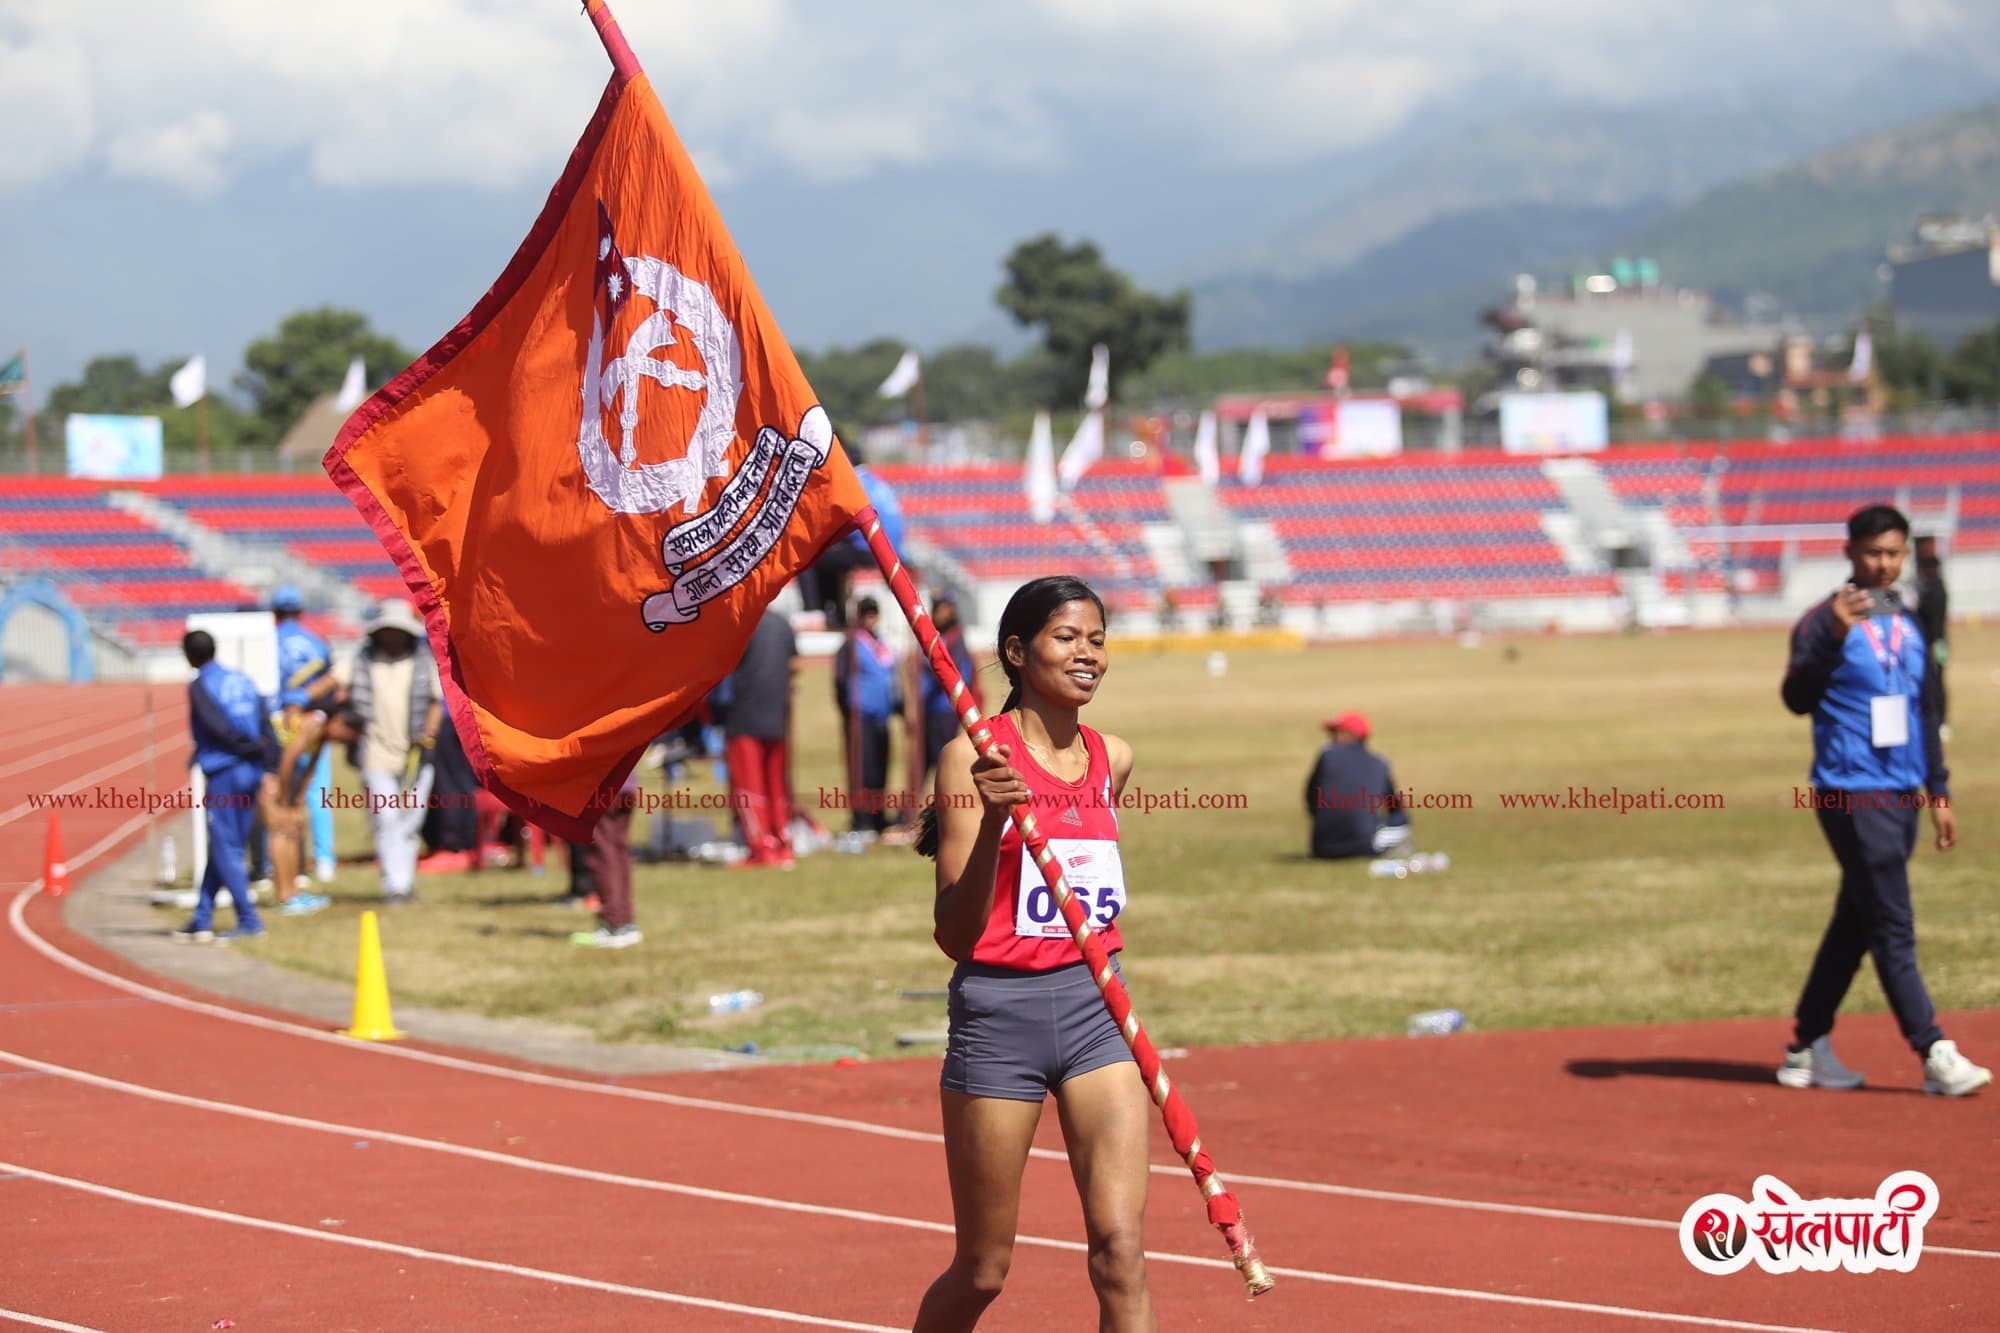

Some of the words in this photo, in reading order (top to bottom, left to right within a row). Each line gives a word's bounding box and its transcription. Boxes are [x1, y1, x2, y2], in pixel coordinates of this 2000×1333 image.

[668, 520, 715, 557] सशस्त्र
[711, 493, 740, 534] प्रहरी
[745, 430, 772, 477] नेपाल
[682, 567, 722, 601] शान्ति
[720, 530, 762, 574] सुरक्षा
